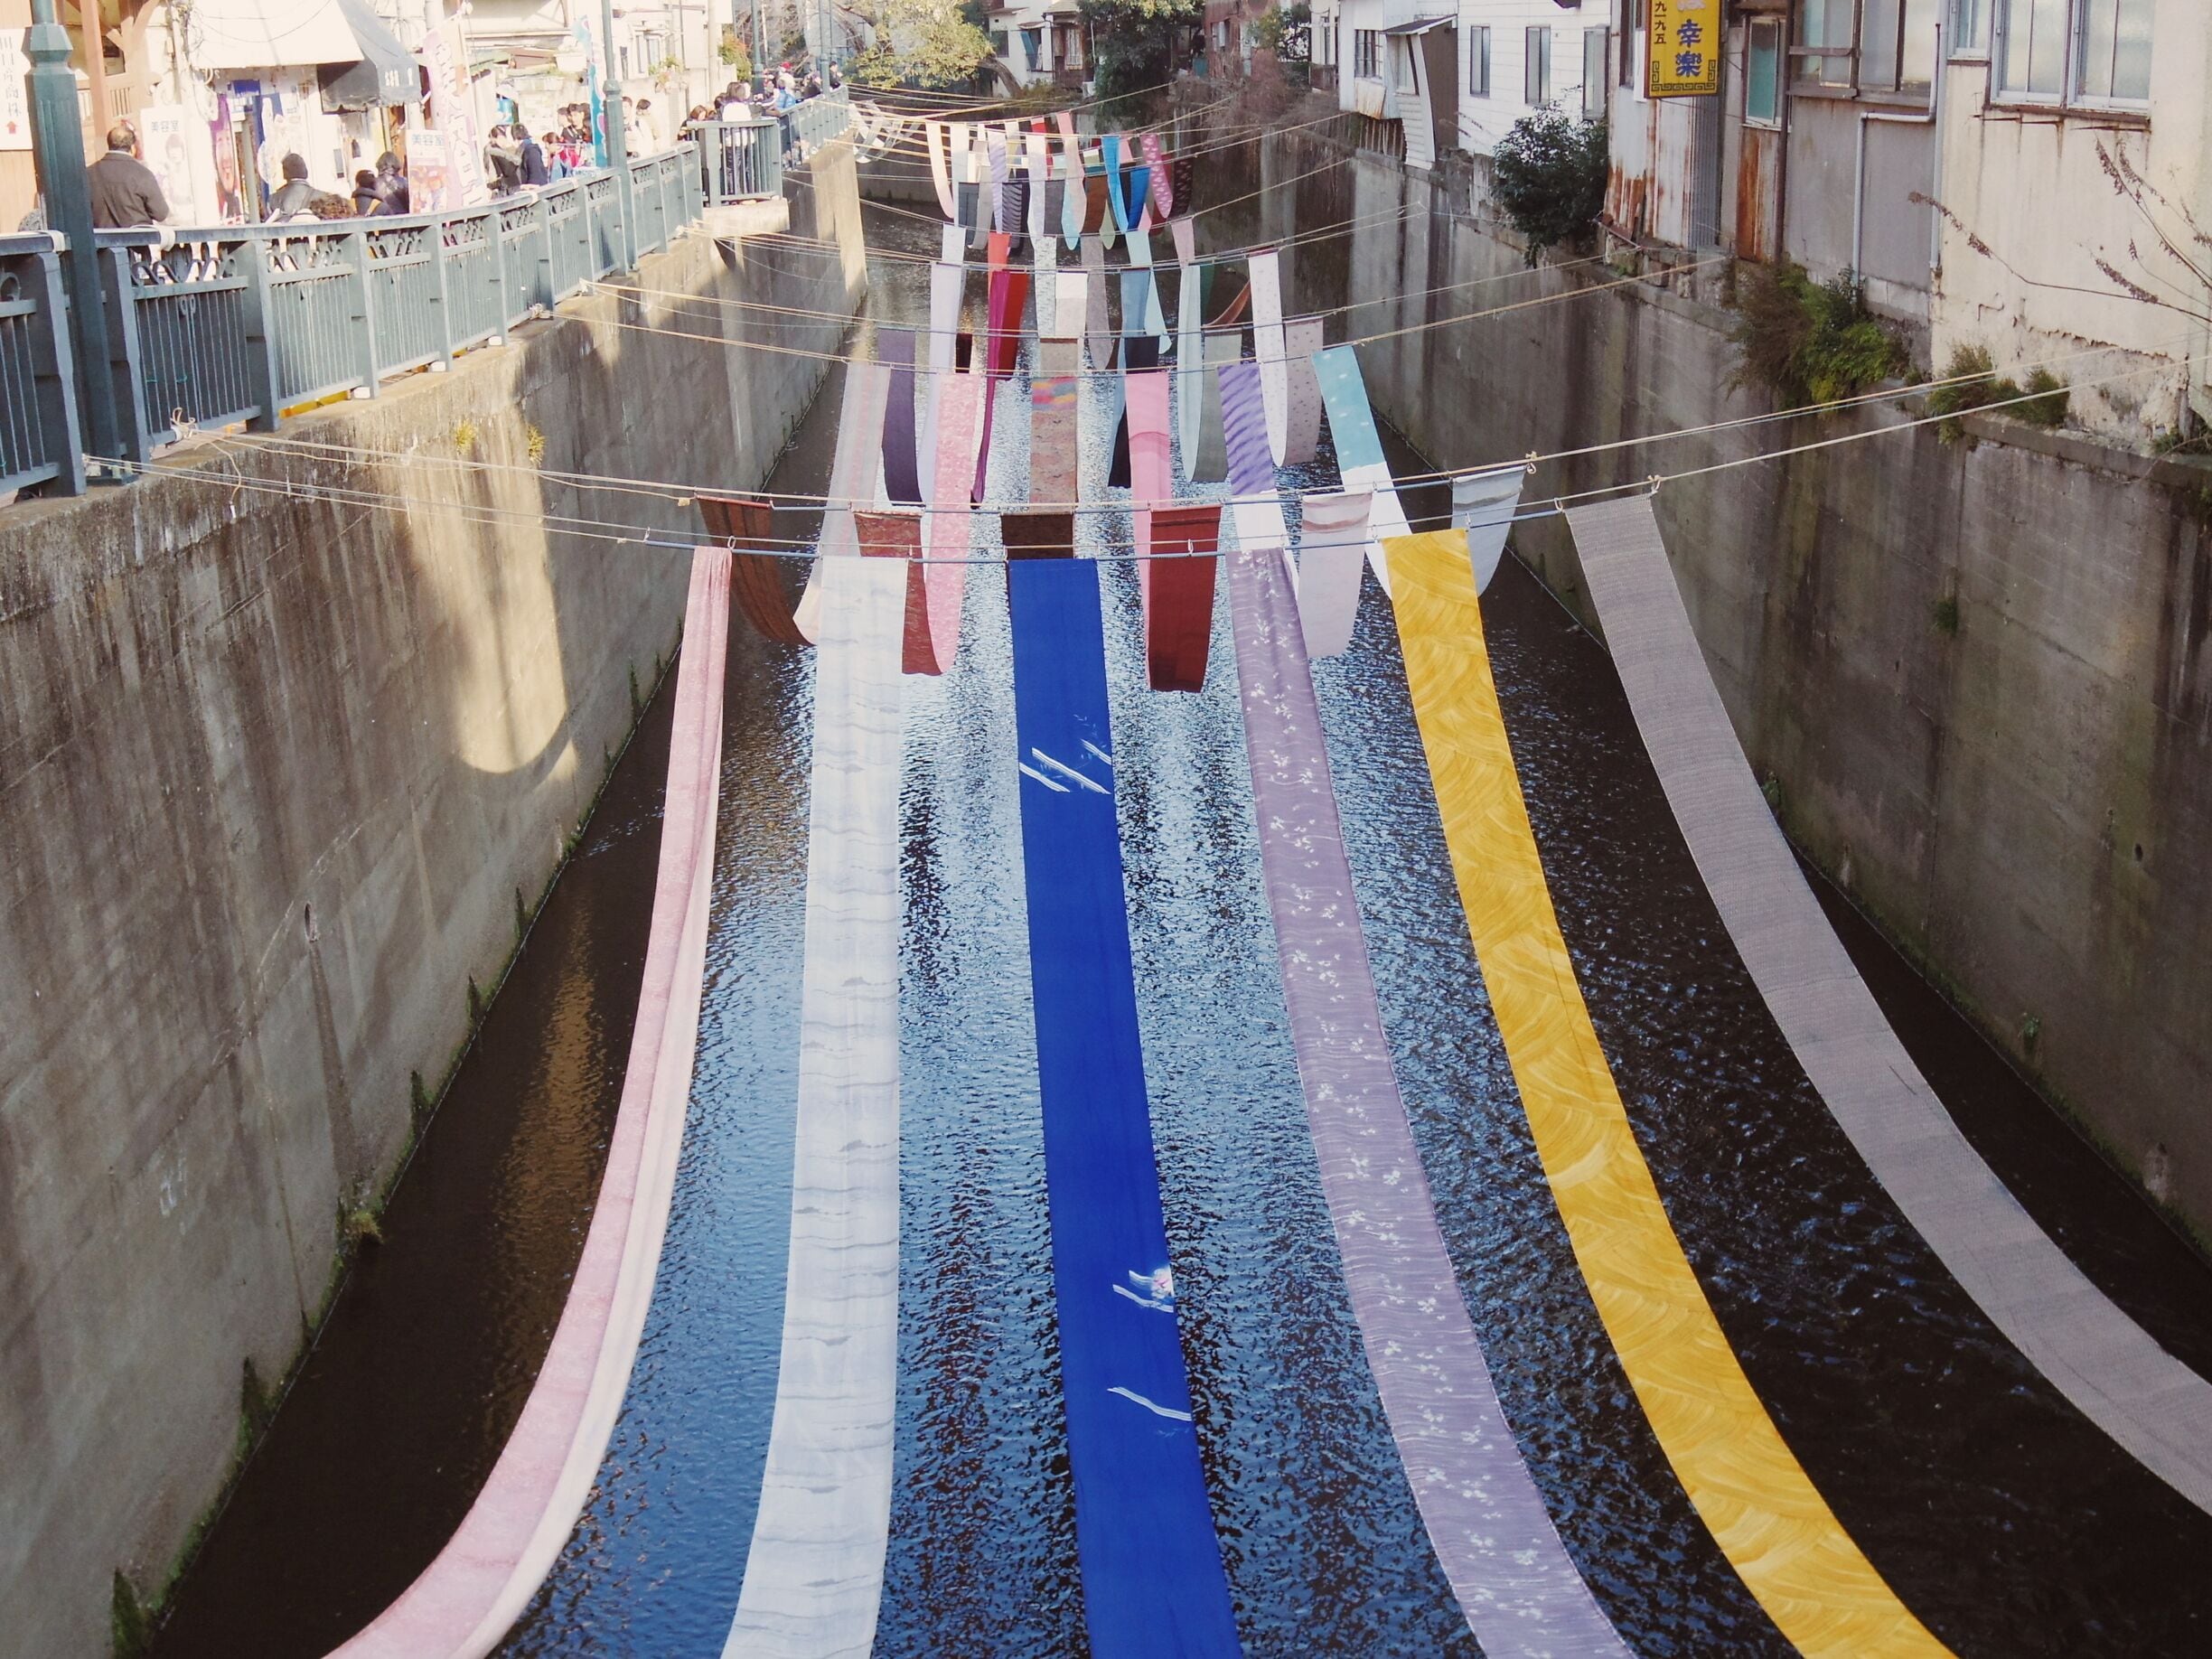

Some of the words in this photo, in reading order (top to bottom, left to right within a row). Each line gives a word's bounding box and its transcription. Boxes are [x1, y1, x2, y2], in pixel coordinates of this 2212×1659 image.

[151, 119, 179, 133] 美容室
[412, 134, 445, 146] 美容室
